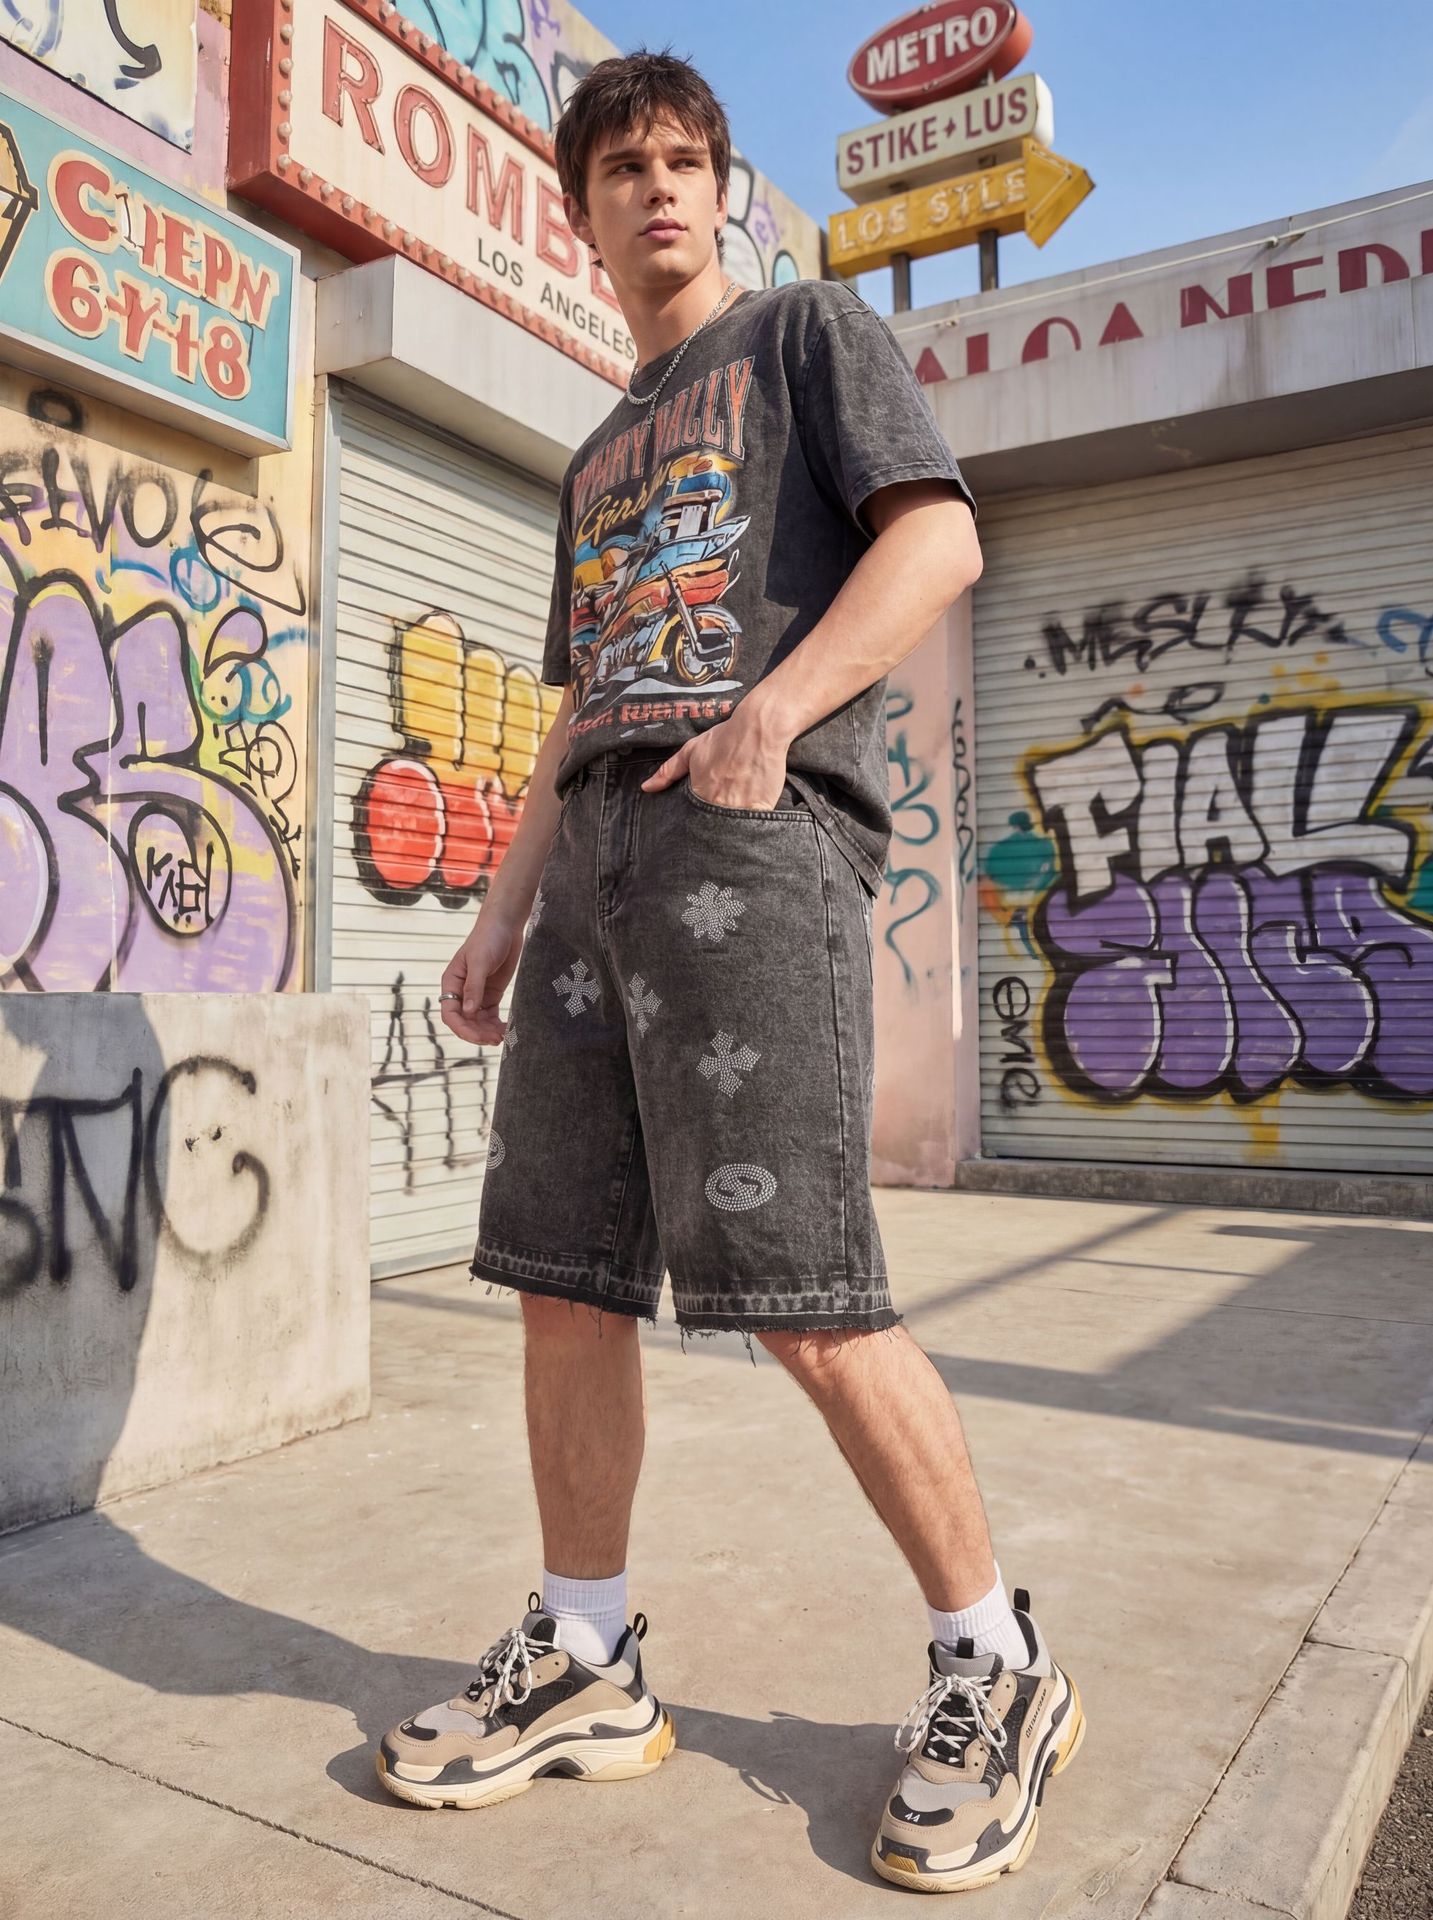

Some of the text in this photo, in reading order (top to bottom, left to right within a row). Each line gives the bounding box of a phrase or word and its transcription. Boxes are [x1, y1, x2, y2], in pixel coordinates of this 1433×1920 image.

[866, 6, 998, 86] METRO
[322, 14, 623, 314] ROMB
[846, 86, 1029, 176] STIKE LUS
[837, 202, 910, 252] LOS
[477, 237, 637, 361] LOS ANGELES
